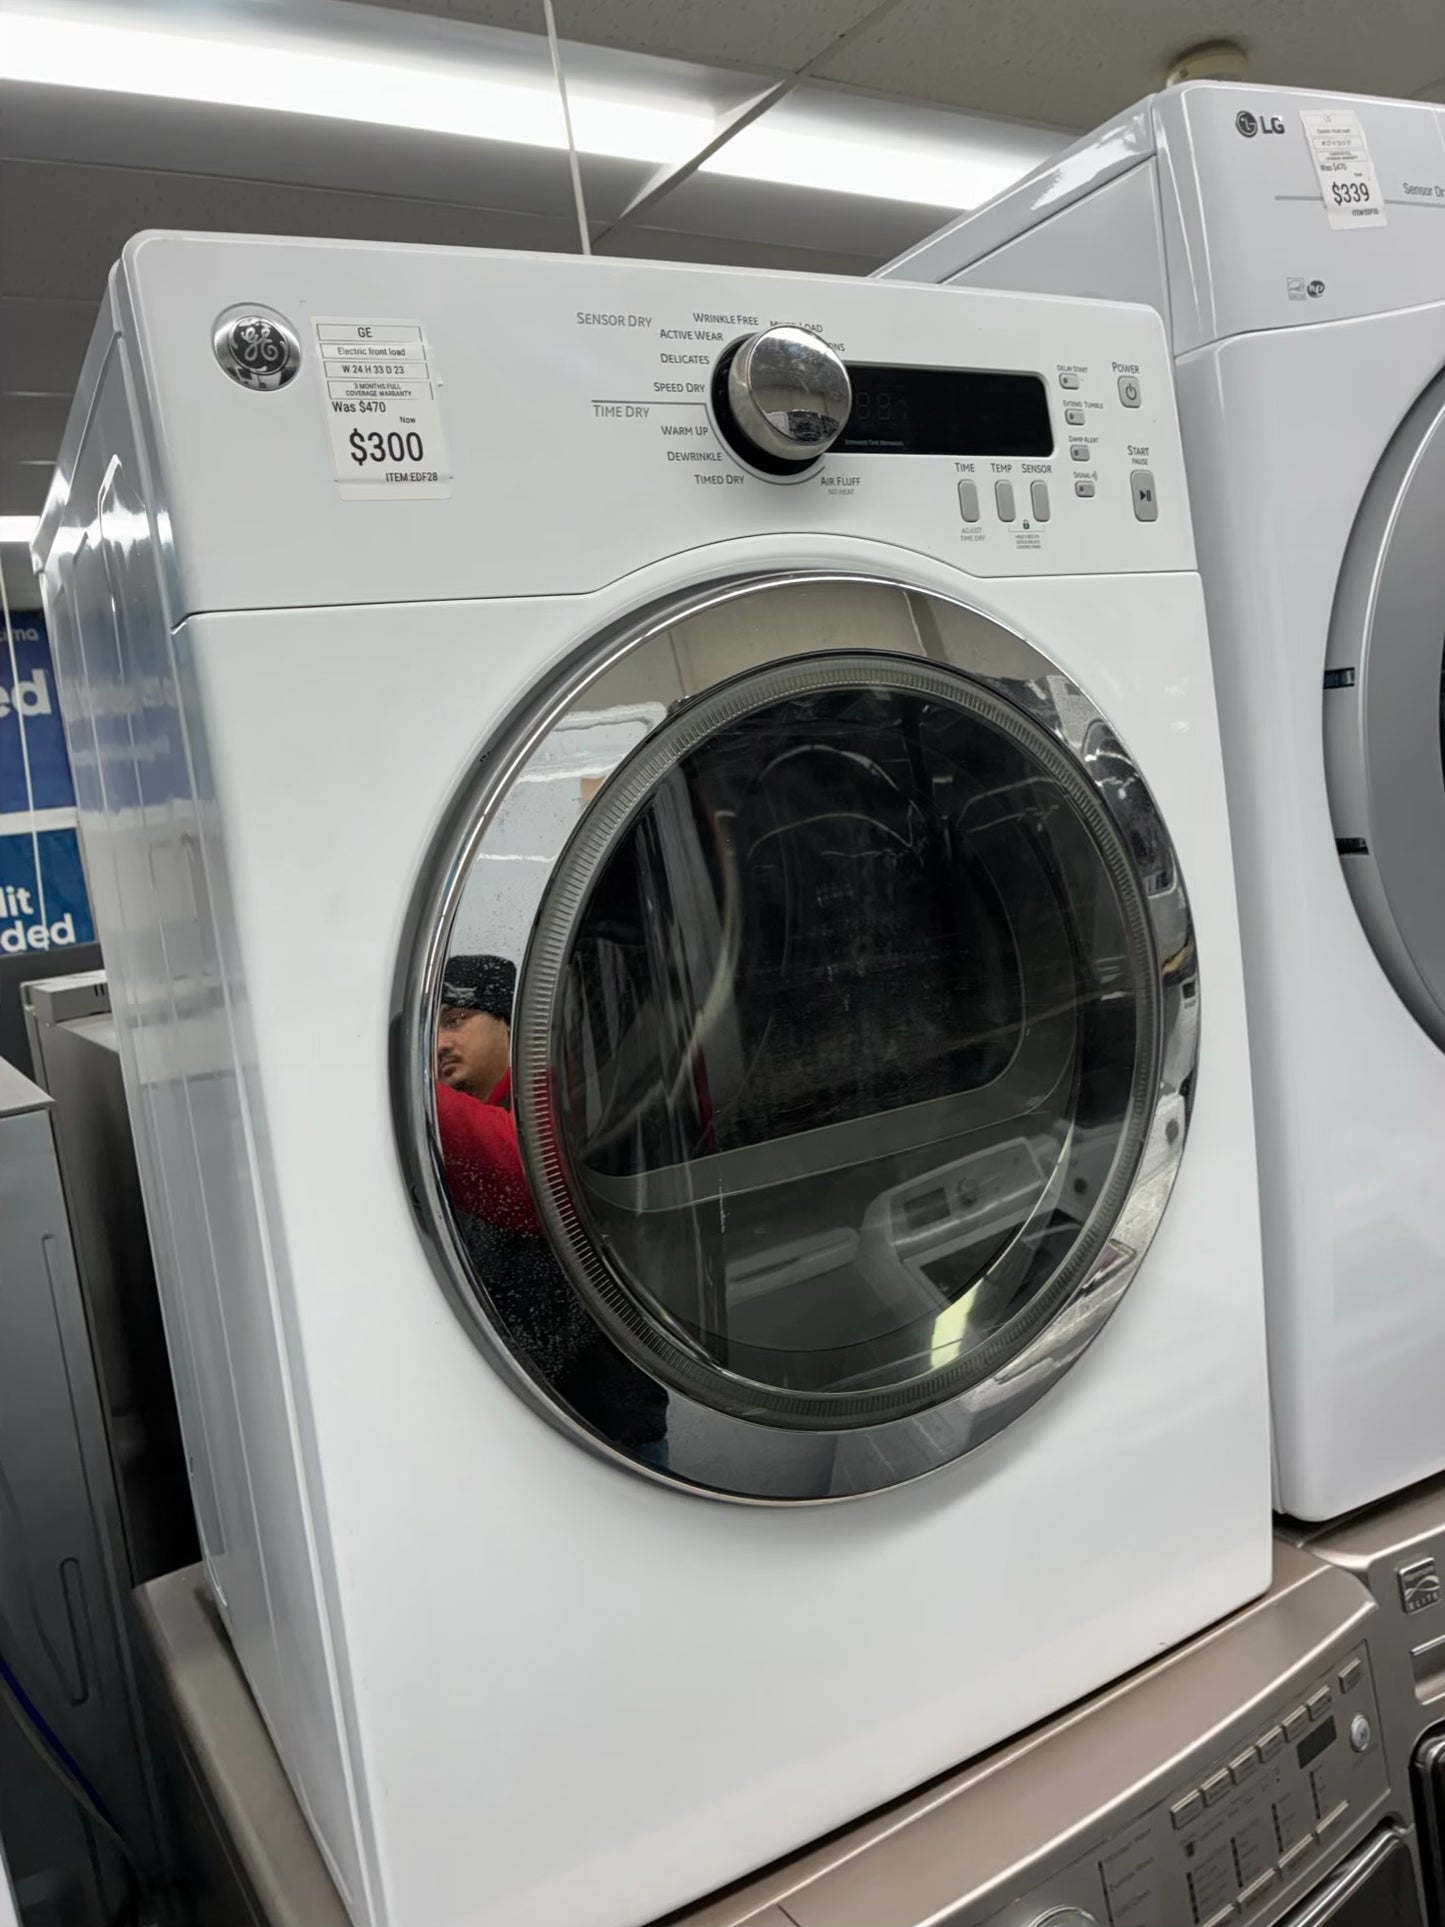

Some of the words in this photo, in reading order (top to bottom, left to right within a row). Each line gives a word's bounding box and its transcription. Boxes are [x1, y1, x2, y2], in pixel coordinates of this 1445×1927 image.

[1259, 115, 1285, 135] LG
[1331, 181, 1370, 206] $339
[1402, 182, 1433, 197] Sensor
[576, 311, 626, 326] SENSOR
[628, 314, 653, 328] DRY
[692, 313, 736, 325] WRINKLE
[737, 314, 760, 326] FREE
[357, 327, 373, 338] GE
[799, 323, 824, 333] OAD
[659, 328, 693, 340] ACTIVE
[694, 329, 724, 342] WEAR
[337, 346, 367, 357] Electric
[368, 346, 387, 357] front
[388, 347, 406, 357] load
[660, 352, 711, 365] DELICATES
[341, 364, 351, 374] W
[351, 364, 364, 374] 24
[365, 364, 372, 374] H
[373, 365, 385, 375] 33
[393, 365, 405, 375] 23
[1073, 365, 1088, 373] START
[1112, 361, 1140, 374] POWER
[360, 382, 385, 390] MONTHS
[653, 382, 684, 393] SPEED
[685, 382, 706, 394] DRY
[345, 389, 378, 398] COVERAGE
[379, 390, 412, 398] WARRANTY
[332, 401, 356, 413] Was
[359, 400, 387, 414] $470
[593, 404, 623, 418] TIME
[625, 405, 650, 418] DRY
[399, 416, 416, 424] Now
[660, 425, 694, 436] WARM
[695, 425, 709, 436] UP
[1068, 435, 1083, 443] DAMP
[1083, 436, 1099, 444] ALERT
[349, 427, 424, 467] $300
[1127, 444, 1150, 456] START
[667, 450, 723, 462] DEWRINKLE
[1131, 457, 1149, 465] PAUSE
[954, 462, 975, 473] TIME
[990, 462, 1013, 473] TEMP
[1021, 463, 1053, 473] SENSOR
[385, 472, 438, 482] ITEM:EDF28
[694, 474, 724, 485] TIMED
[726, 474, 745, 486] DRY
[821, 476, 836, 486] AIR
[836, 475, 861, 486] FLUFF
